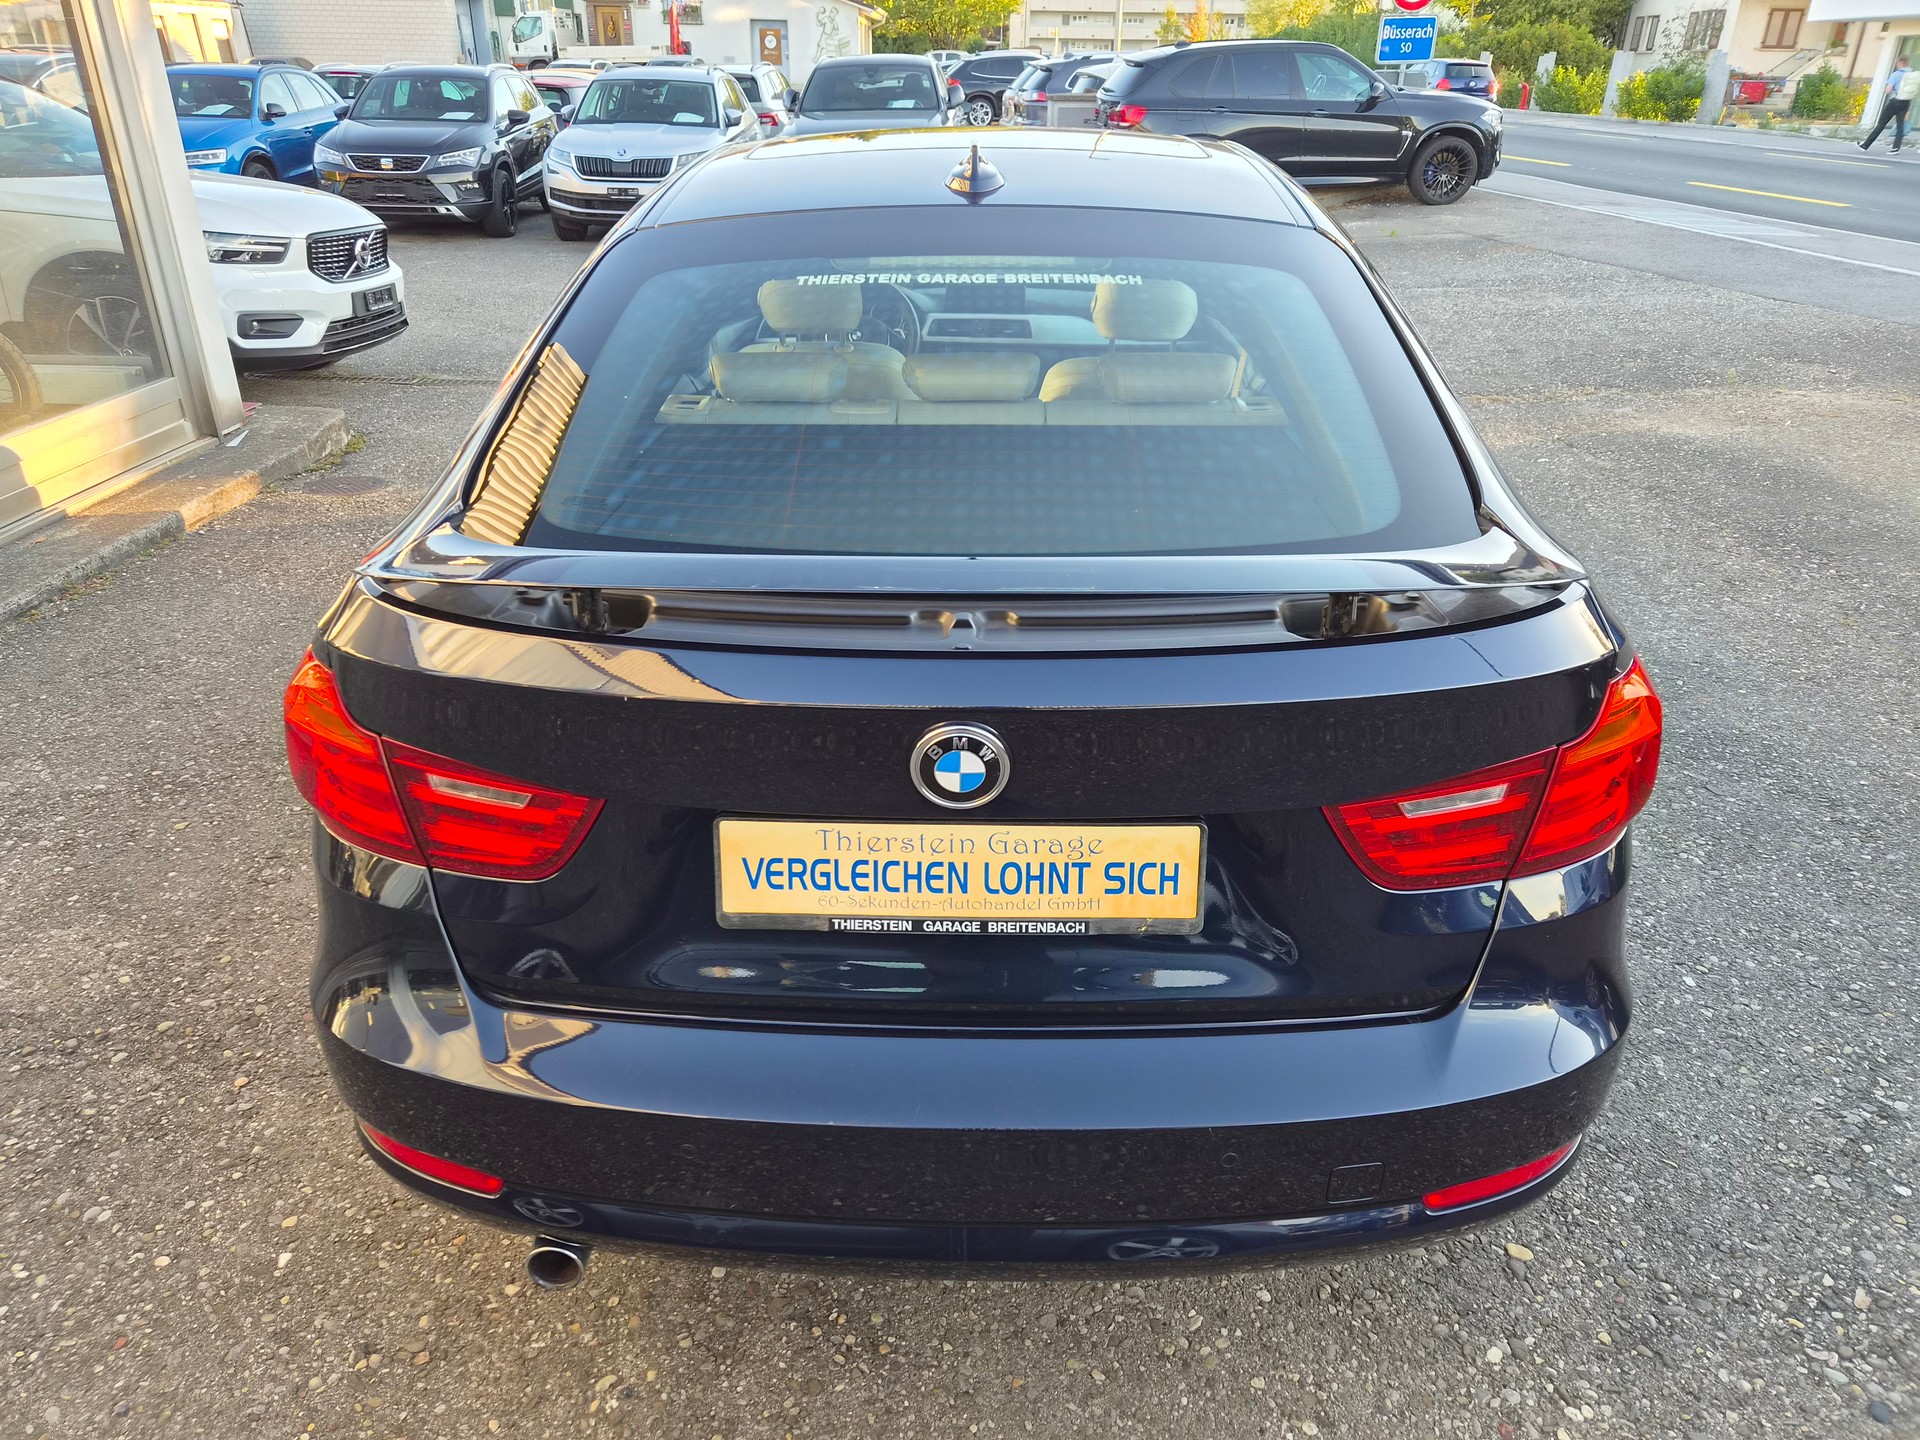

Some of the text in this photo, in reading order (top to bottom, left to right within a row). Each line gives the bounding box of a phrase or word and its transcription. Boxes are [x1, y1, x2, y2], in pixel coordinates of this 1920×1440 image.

[1383, 24, 1433, 40] Büsserach
[1400, 42, 1412, 53] SO
[796, 273, 1143, 286] THIERSTEIN GARAGE BREITENBACH
[926, 737, 998, 762] BMW
[815, 828, 1104, 860] Thierstein Garage
[741, 857, 1180, 895] VERGLEICHEN LOHNT SICH
[818, 894, 1101, 911] 60-Sekunden-Autohandel GmbH
[832, 918, 1086, 933] THIERSTEIN GARAGE BREITENBACH
